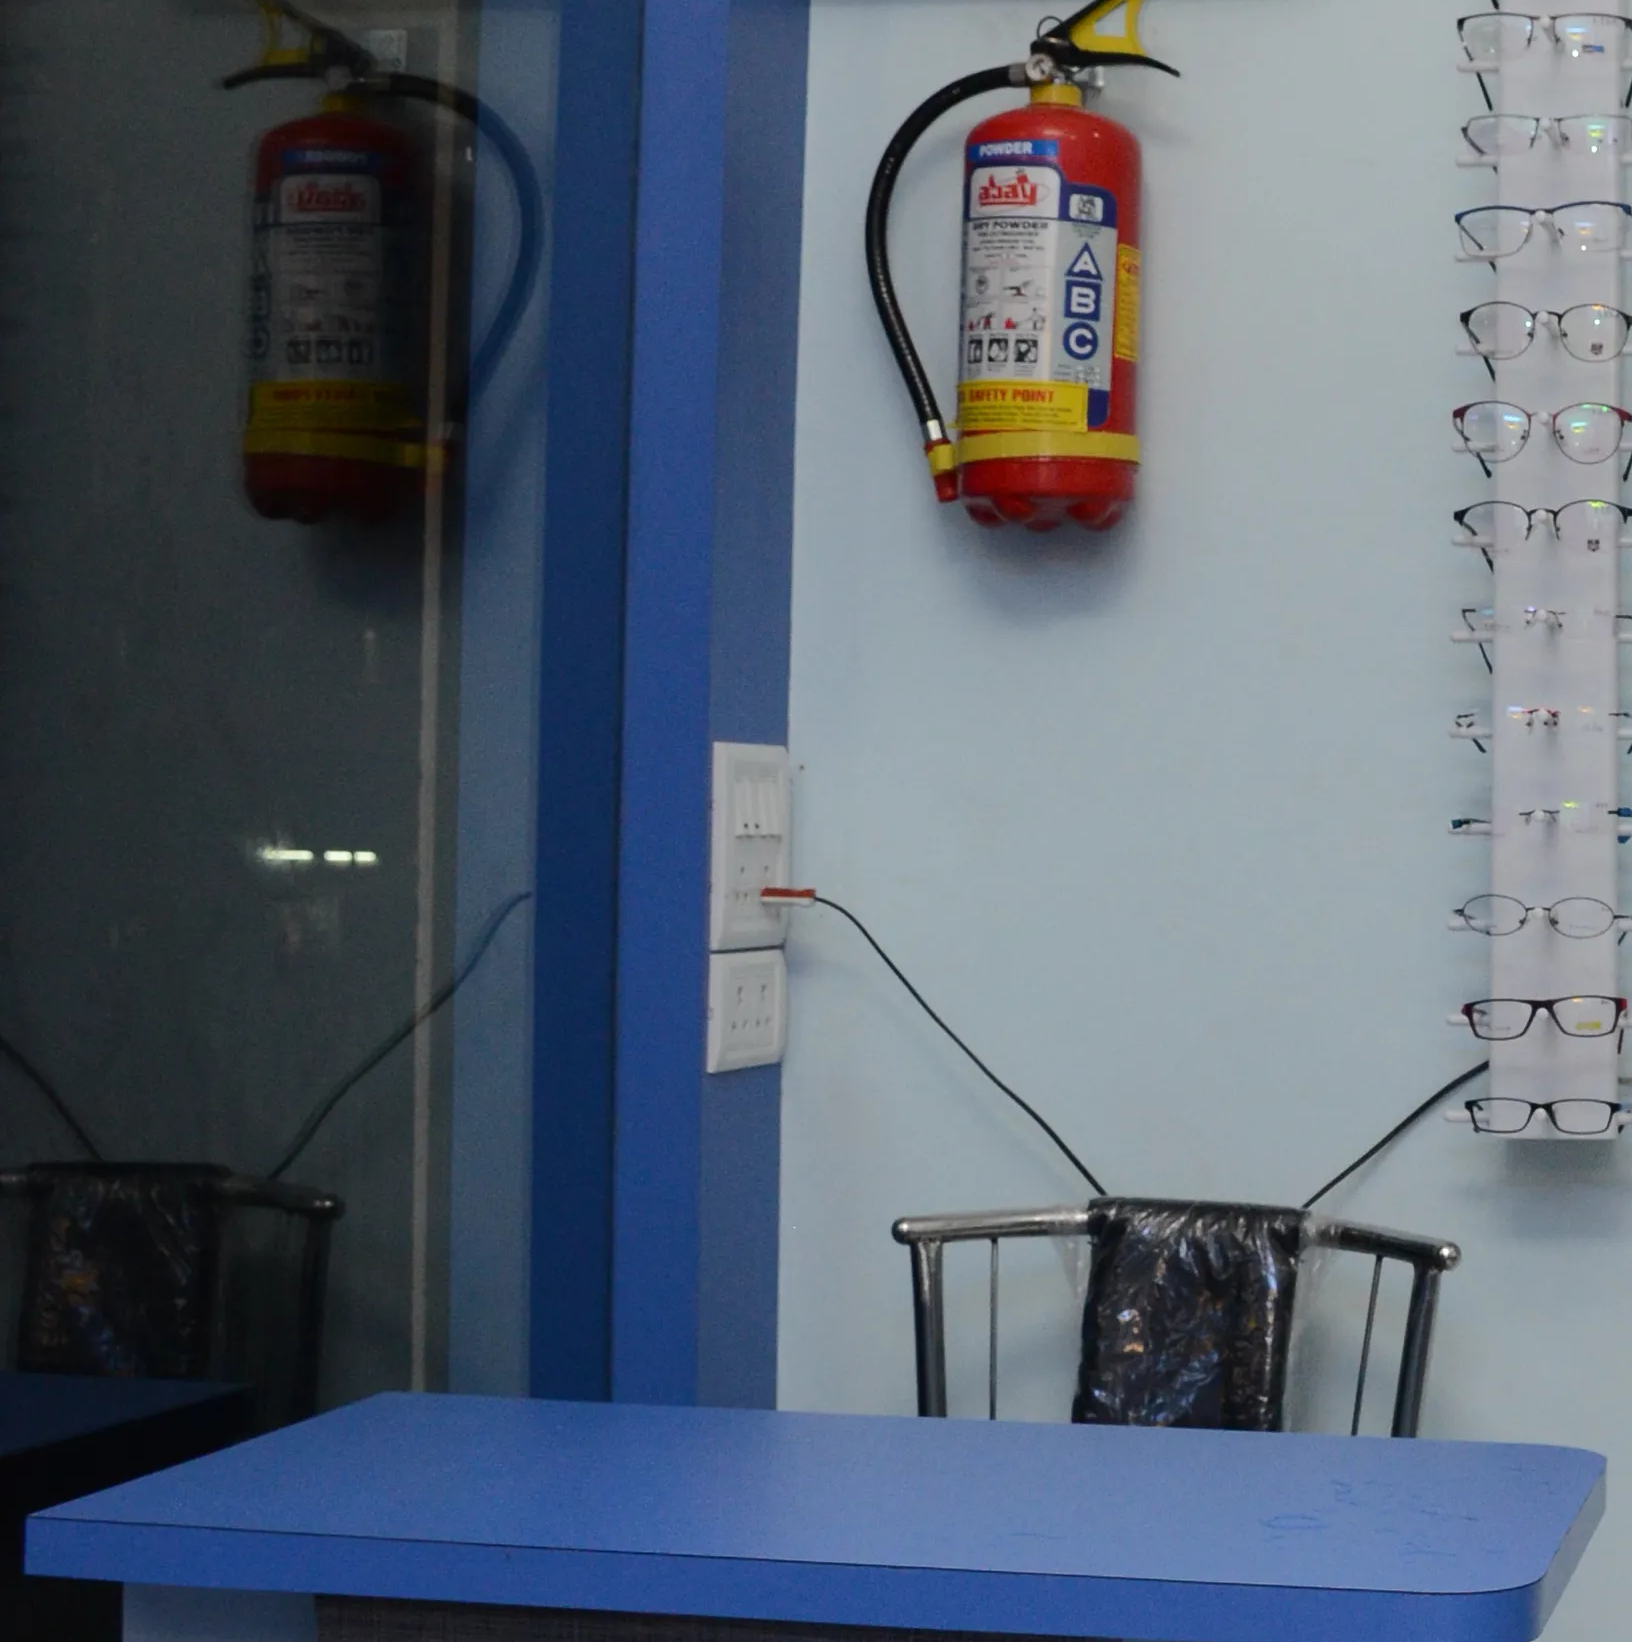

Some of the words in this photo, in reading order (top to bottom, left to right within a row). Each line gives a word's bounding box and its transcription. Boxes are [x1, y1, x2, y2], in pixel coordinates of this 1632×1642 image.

[979, 141, 1033, 156] POWDER
[992, 220, 1048, 230] POWDER
[1073, 250, 1097, 275] A
[1070, 286, 1096, 314] B
[1069, 328, 1093, 355] C
[970, 389, 1007, 403] SAFETY
[1012, 389, 1055, 404] POINT
